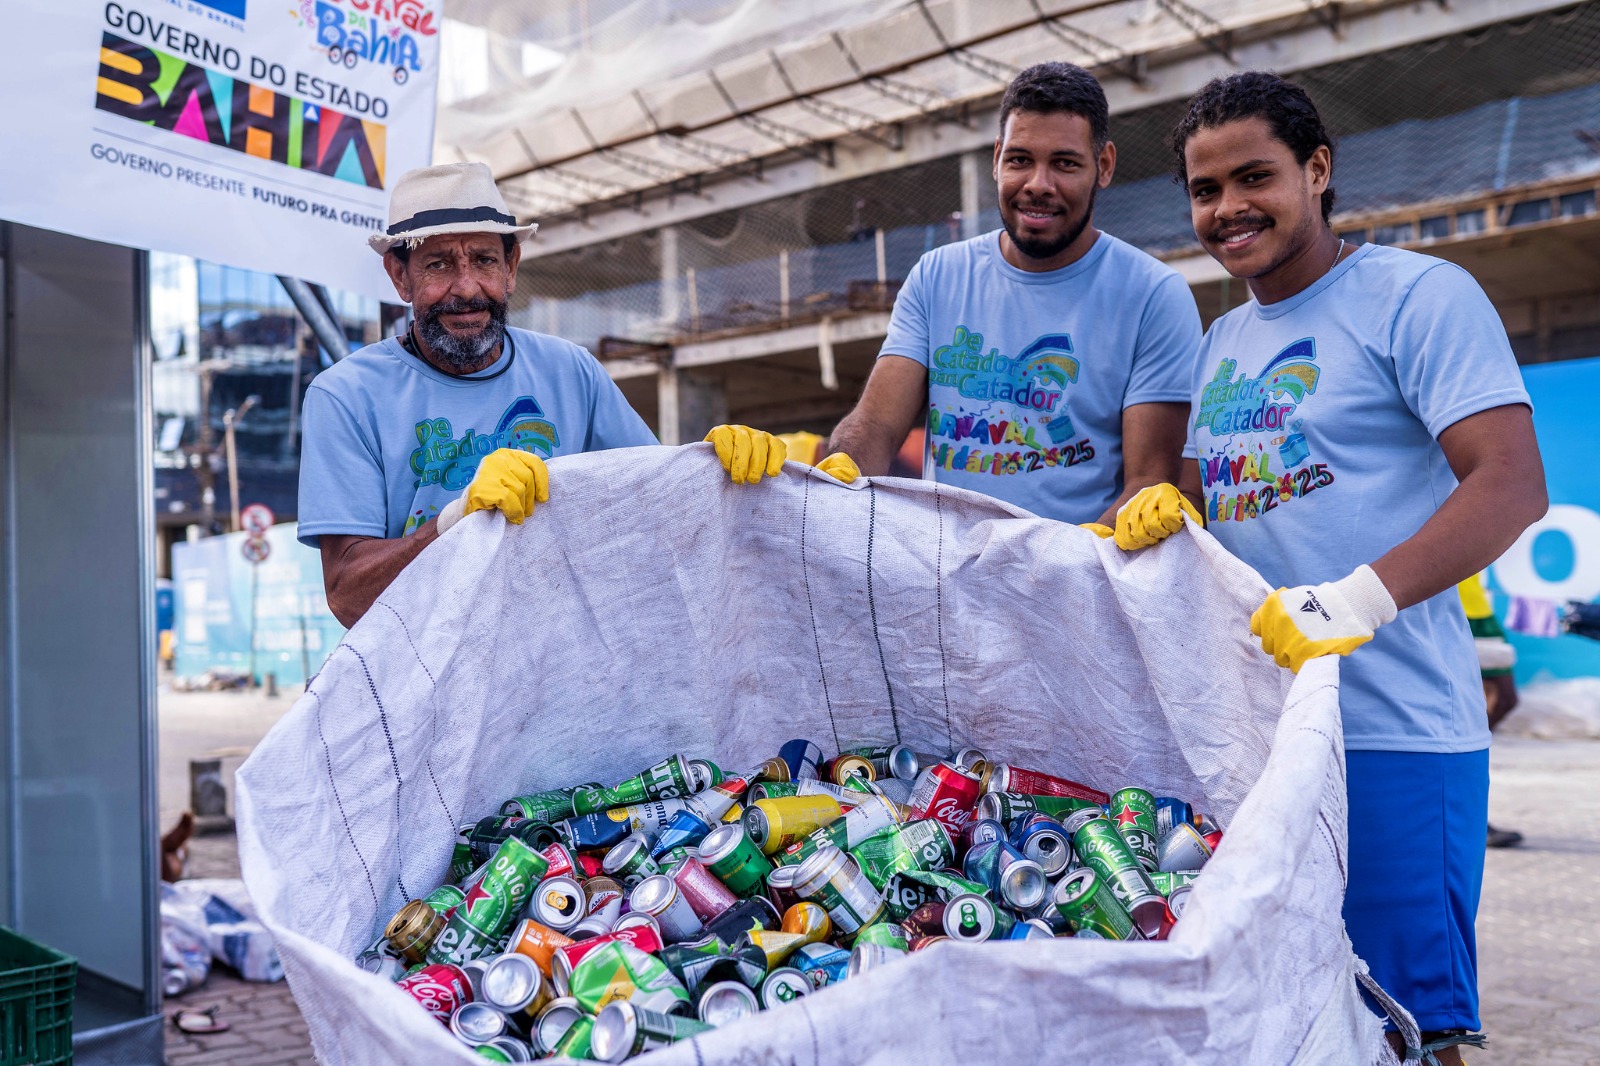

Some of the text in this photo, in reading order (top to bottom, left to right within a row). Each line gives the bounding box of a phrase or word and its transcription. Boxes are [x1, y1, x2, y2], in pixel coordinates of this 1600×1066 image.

[105, 2, 389, 119] GOVERNO DO ESTADO
[95, 30, 387, 190] BAHIA
[90, 143, 384, 232] GOVERNO PRESENTE FUTURO PRA GENTE
[953, 325, 982, 350] De
[934, 347, 1021, 377] Catador
[1213, 358, 1237, 383] De
[959, 373, 1061, 411] Catador
[415, 419, 451, 447] De
[1210, 396, 1296, 435] Catador
